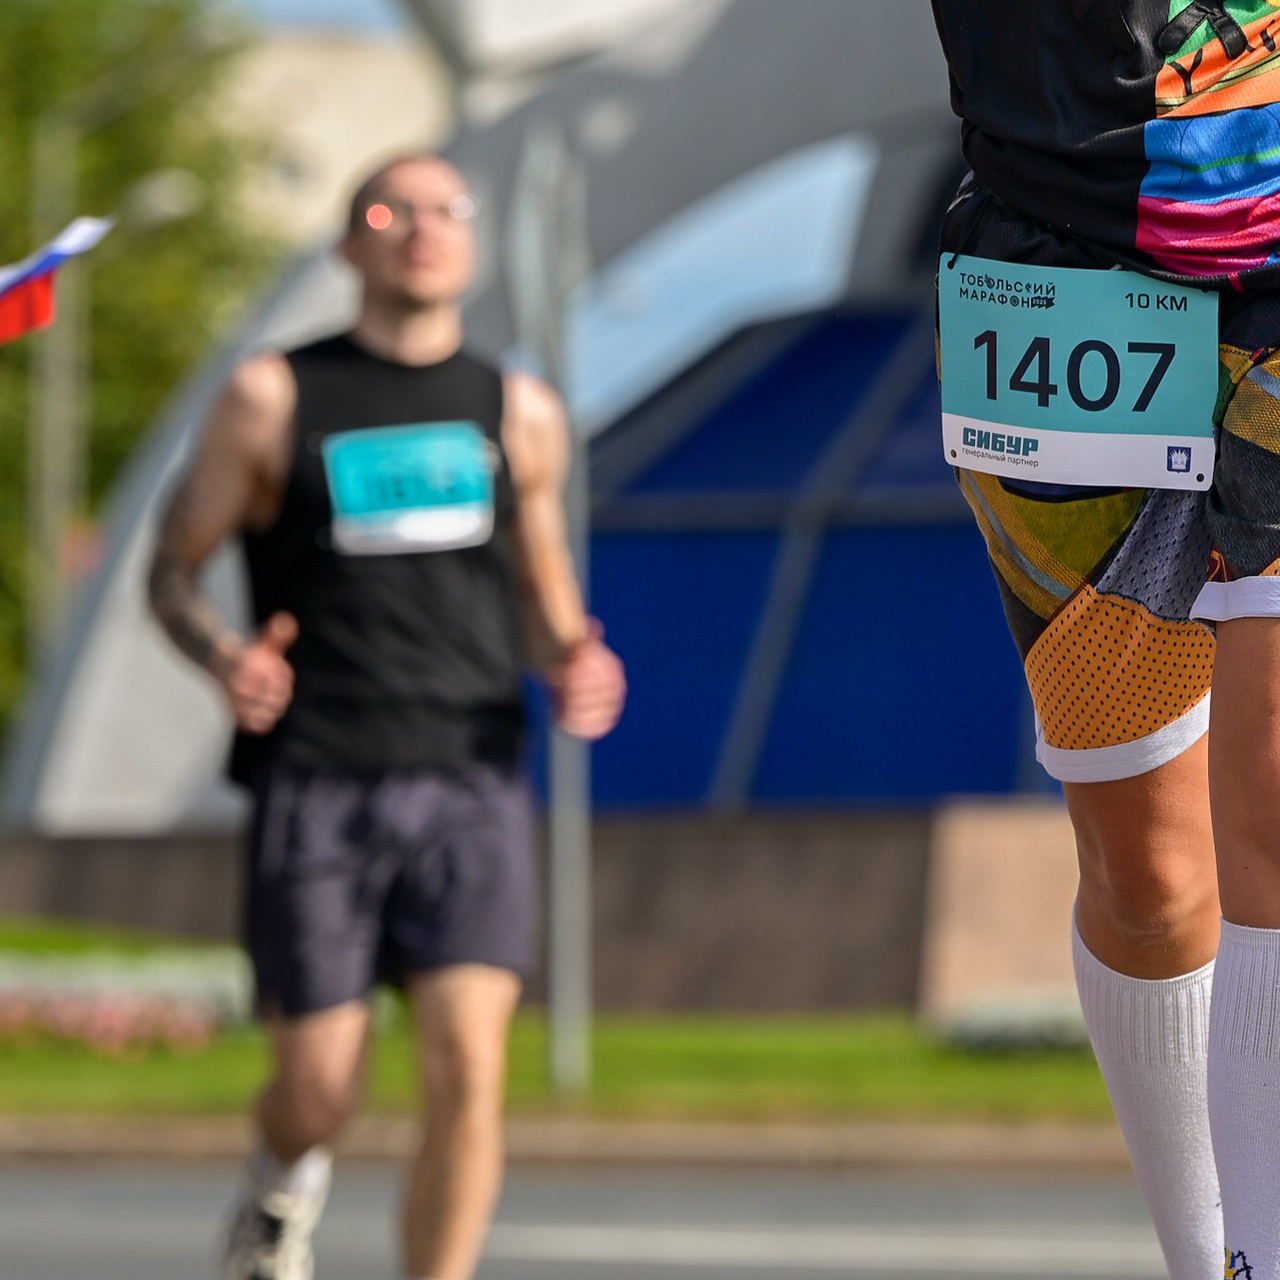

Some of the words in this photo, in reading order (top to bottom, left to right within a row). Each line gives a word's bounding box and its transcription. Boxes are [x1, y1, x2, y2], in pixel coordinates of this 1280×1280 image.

[960, 273, 1055, 295] ТОБОЛЬСКИЙ
[960, 287, 1030, 308] МАРАФОН
[1125, 292, 1149, 309] 10
[973, 329, 1176, 413] 1407
[963, 427, 1039, 456] СИБУР
[962, 448, 1006, 462] генеральный
